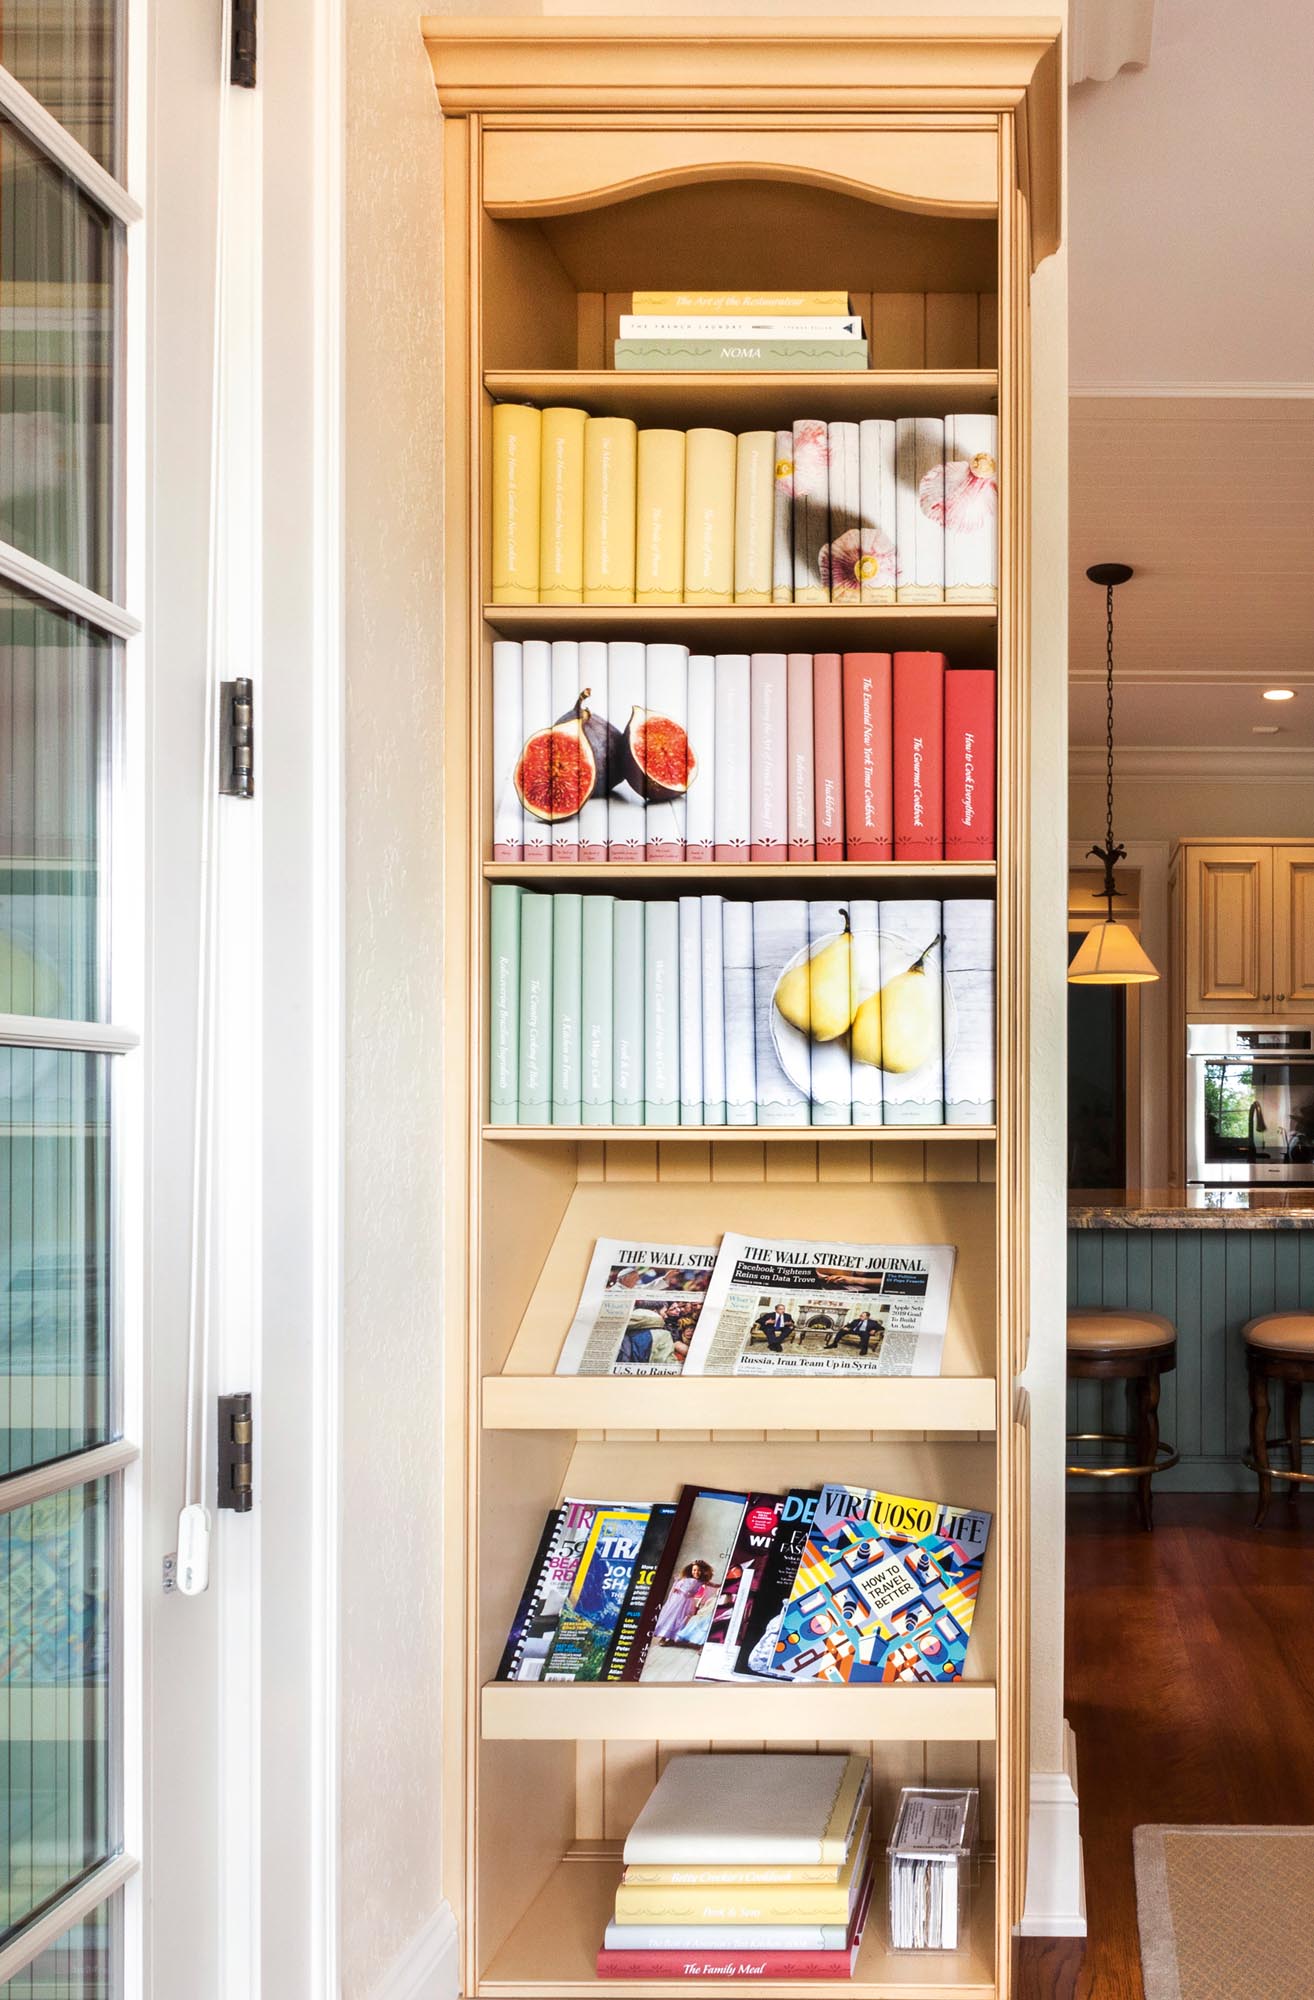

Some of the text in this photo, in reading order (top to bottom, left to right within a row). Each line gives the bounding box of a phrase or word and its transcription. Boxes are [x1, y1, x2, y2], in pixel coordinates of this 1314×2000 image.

[676, 296, 695, 307] The
[696, 297, 712, 306] Art
[712, 296, 722, 310] of
[724, 297, 741, 306] the
[720, 347, 762, 359] NOMA
[862, 678, 875, 828] The Essential New York Times Cookbook
[914, 738, 924, 827] The Gourmet Cookbook
[962, 732, 975, 827] How to Cook Everything
[822, 778, 835, 828] Huckleberry
[530, 979, 540, 992] The
[528, 994, 538, 1028] Country
[562, 1014, 572, 1022] A
[562, 1022, 572, 1054] Kitchen
[592, 1024, 600, 1038] The
[590, 1040, 600, 1058] Way
[529, 1060, 538, 1070] of
[592, 1059, 600, 1068] to
[562, 1064, 572, 1090] France
[618, 1250, 647, 1264] THE
[650, 1252, 685, 1266] WALL
[744, 1246, 772, 1262] THE
[776, 1250, 810, 1265] WALL
[812, 1252, 864, 1269] STREET
[735, 1270, 758, 1278] Reins
[772, 1274, 790, 1282] Data
[737, 1262, 812, 1276] Facebook Tightens
[893, 1304, 910, 1312] Apple
[612, 1366, 633, 1375] U.S.
[636, 1367, 647, 1375] to
[776, 1358, 797, 1366] Iran
[799, 1358, 824, 1368] Team
[826, 1360, 839, 1369] Up
[840, 1360, 850, 1368] in
[851, 1361, 878, 1370] Syria
[824, 1492, 984, 1544] VIRTUOSO LIFE
[750, 1535, 774, 1548] WI
[861, 1565, 900, 1591] HOW TO
[867, 1575, 907, 1599] TRAVEL
[874, 1583, 914, 1610] BETTER
[672, 1872, 697, 1882] Betty
[745, 1872, 792, 1881] Cookbook
[682, 1962, 767, 1977] The Family Meal
